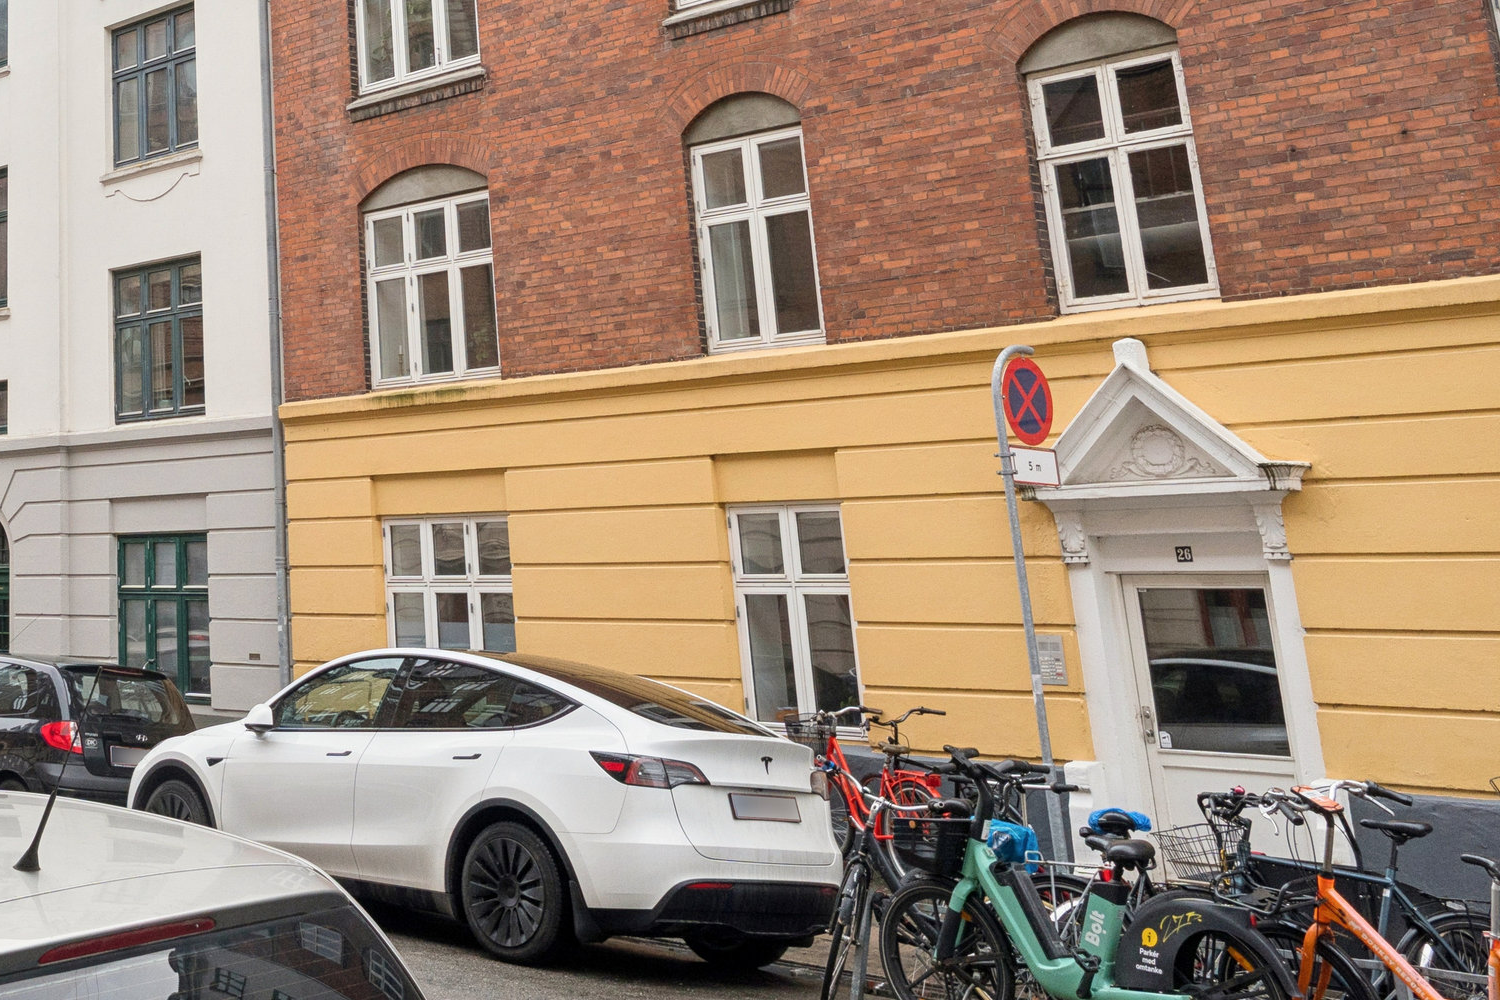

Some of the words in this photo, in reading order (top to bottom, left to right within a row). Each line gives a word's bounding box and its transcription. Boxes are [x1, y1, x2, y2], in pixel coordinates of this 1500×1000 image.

[1028, 461, 1033, 471] 5
[1035, 464, 1042, 472] m
[1177, 548, 1192, 561] 26
[1084, 910, 1107, 947] Bolt
[1360, 931, 1396, 967] DONKEY
[1141, 957, 1156, 966] med
[1135, 963, 1163, 975] omtanke
